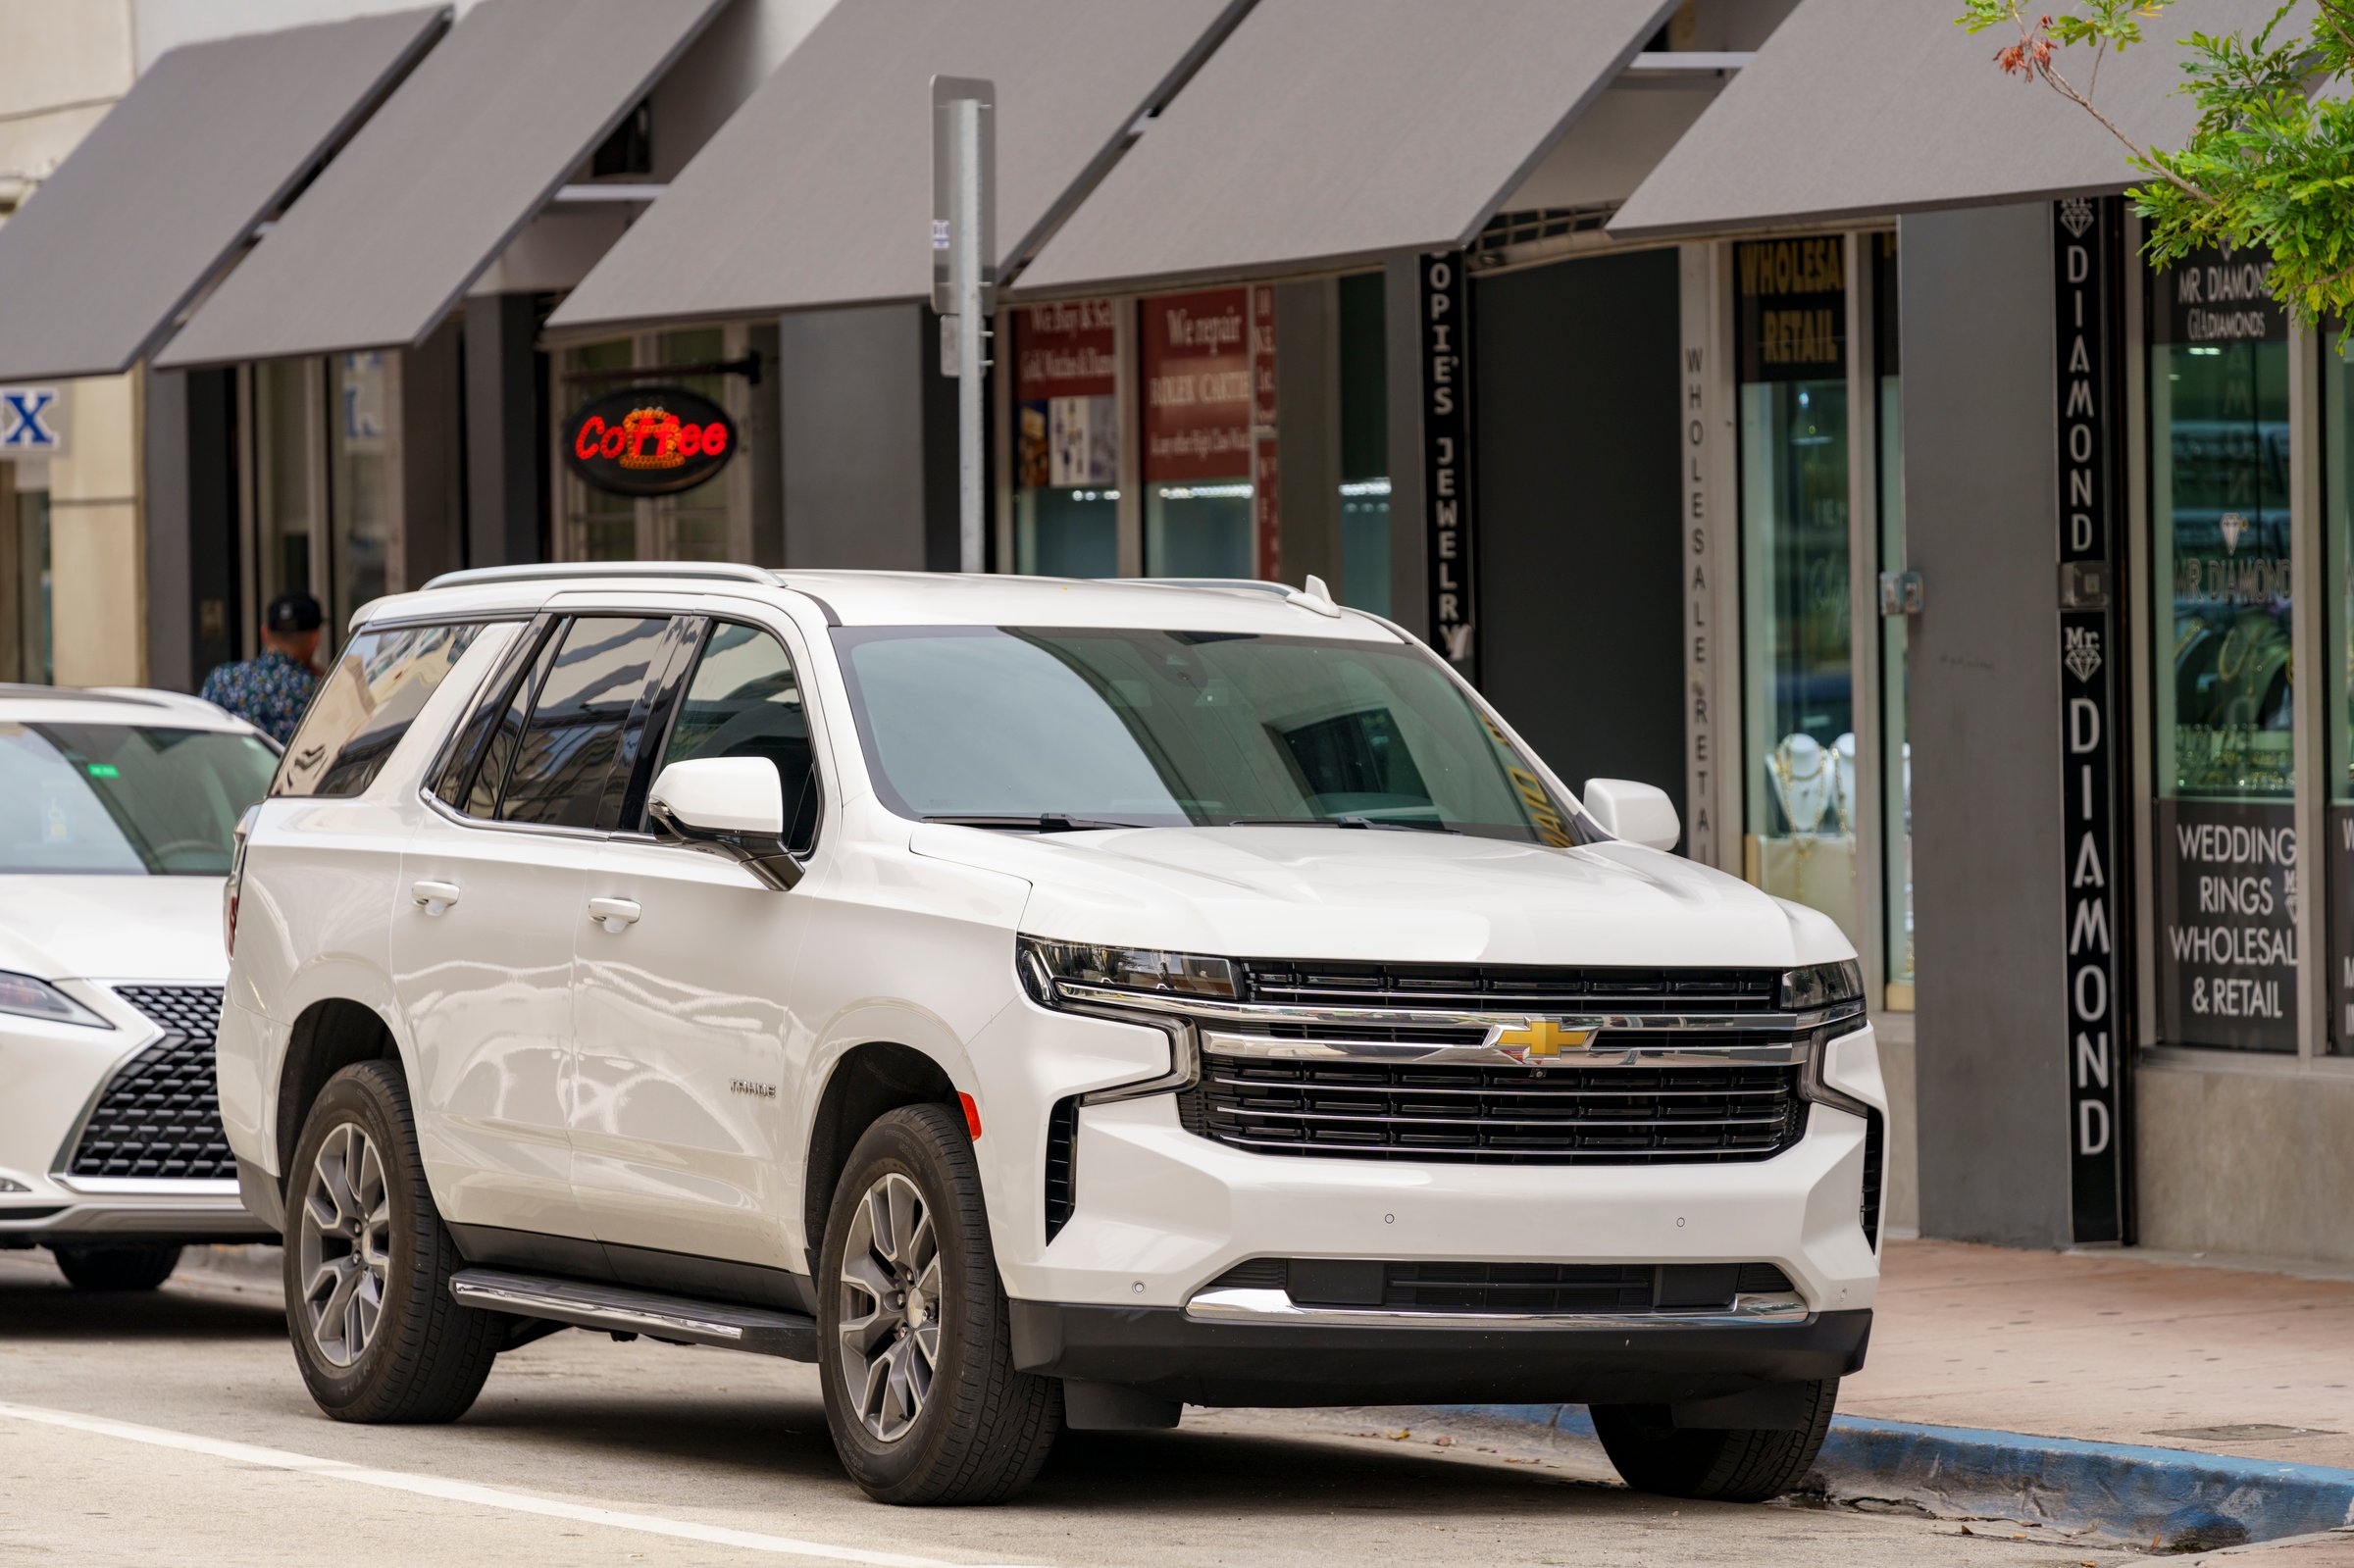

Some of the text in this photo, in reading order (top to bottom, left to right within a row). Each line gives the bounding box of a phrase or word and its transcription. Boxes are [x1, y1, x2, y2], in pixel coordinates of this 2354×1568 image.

[1739, 238, 1845, 296] WHOLESA
[1165, 306, 1242, 356] We repair
[1429, 251, 1459, 416] OPIE'S
[1765, 309, 1838, 363] RETAIL
[1150, 375, 1195, 407] ROLEX
[2067, 245, 2094, 551] DIAMOND
[575, 415, 729, 460] Coffee
[1686, 348, 1706, 663] WHOLESALE
[2208, 557, 2292, 604] DIAMOND
[2176, 824, 2297, 867] WEDDING
[2065, 627, 2111, 1155] Mr. DIAMOND
[2200, 875, 2274, 916] RINGS
[2169, 925, 2298, 966] WHOLESAL
[2192, 977, 2282, 1019] & RETAIL
